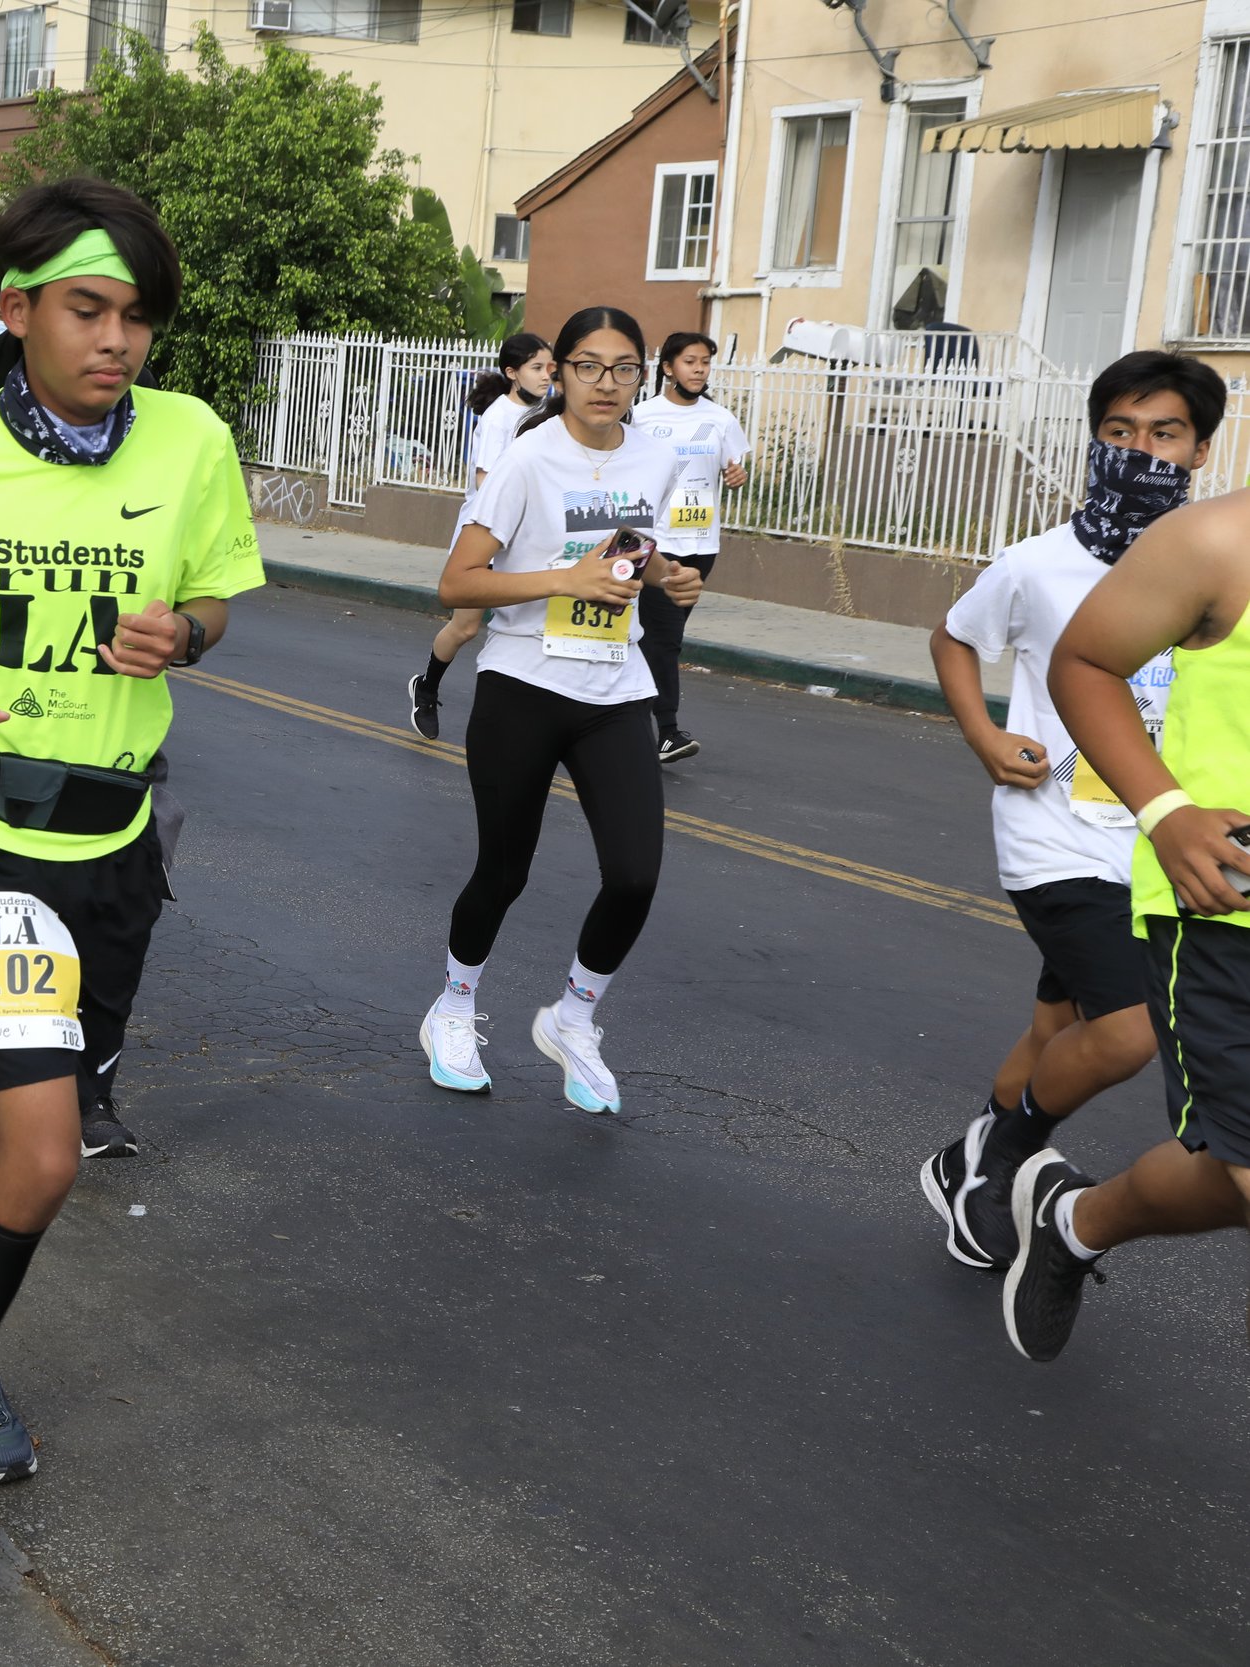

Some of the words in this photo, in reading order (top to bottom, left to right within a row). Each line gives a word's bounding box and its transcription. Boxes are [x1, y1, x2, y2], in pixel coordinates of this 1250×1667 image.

[1148, 458, 1177, 475] LA
[684, 495, 699, 506] LA
[677, 508, 707, 522] 1344
[563, 540, 599, 555] Stu
[571, 599, 614, 629] 831
[610, 650, 625, 661] 831
[1151, 666, 1175, 688] RU
[49, 688, 67, 698] The
[47, 699, 88, 710] McCourt
[46, 709, 96, 721] Foundation
[1142, 717, 1164, 726] ents
[51, 1018, 65, 1027] BAG
[62, 1030, 81, 1048] 102
